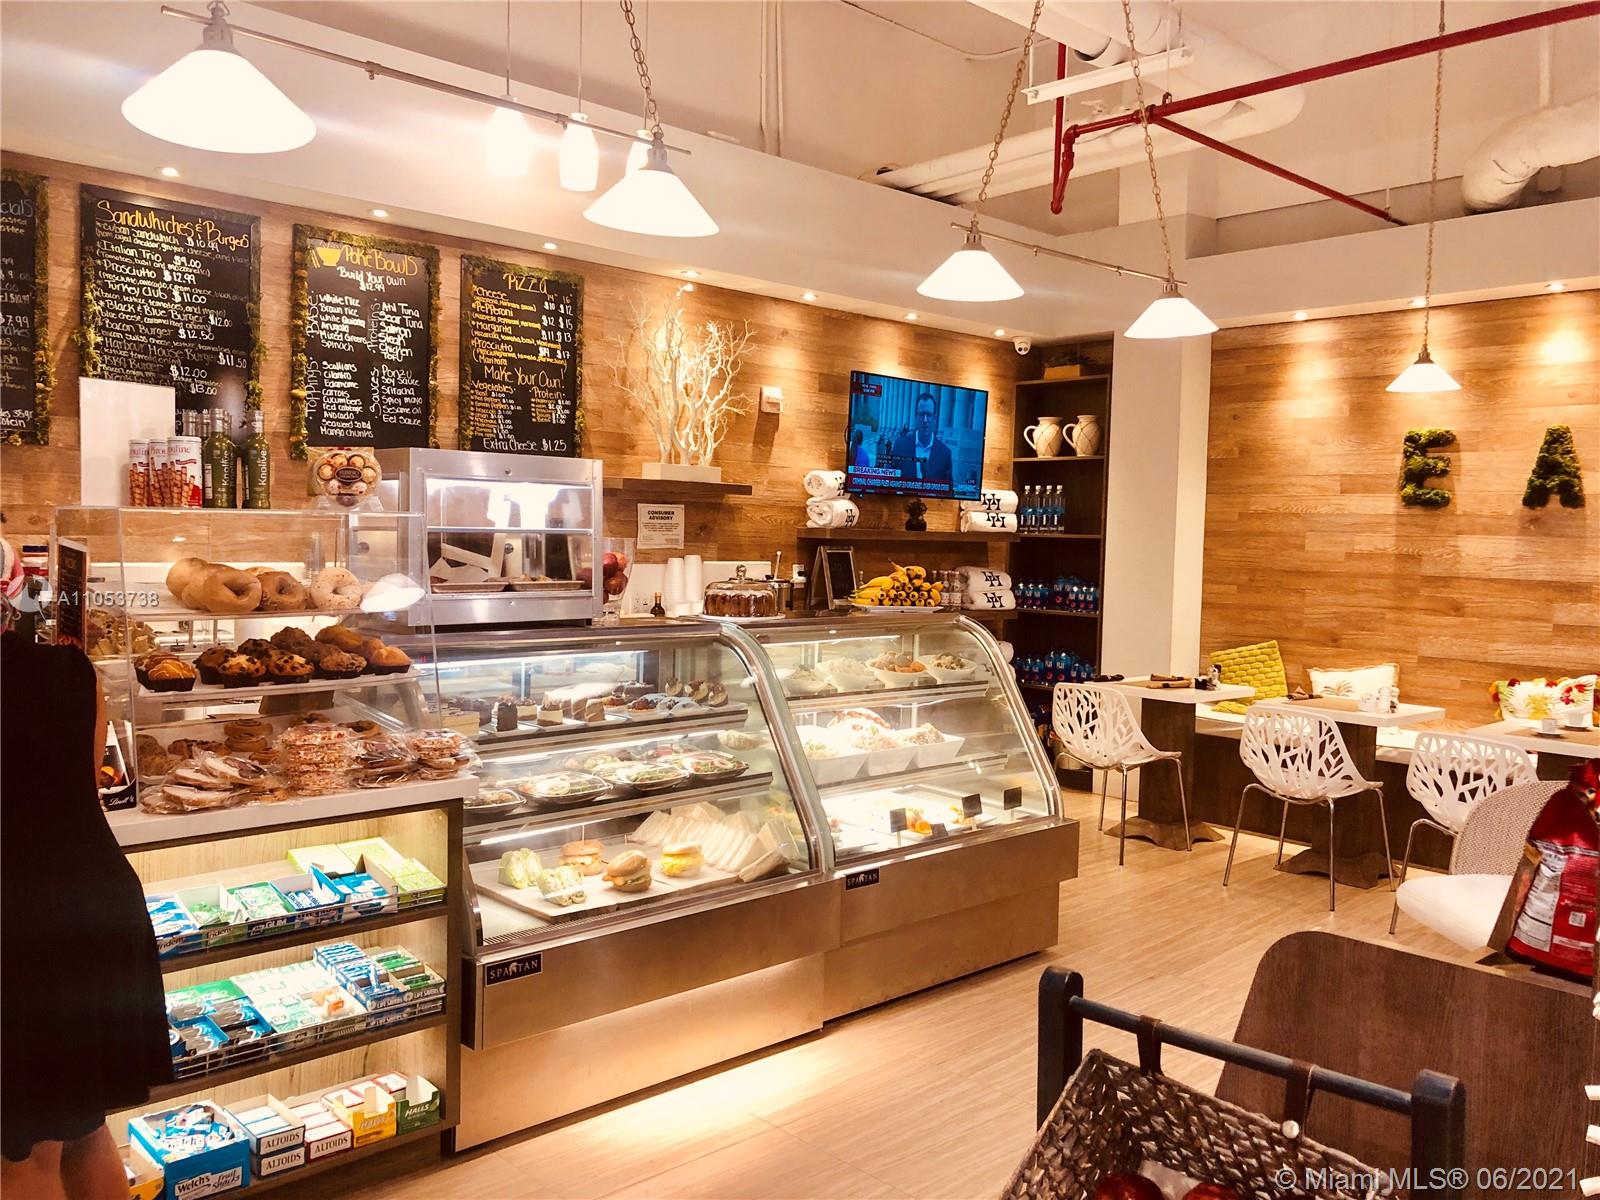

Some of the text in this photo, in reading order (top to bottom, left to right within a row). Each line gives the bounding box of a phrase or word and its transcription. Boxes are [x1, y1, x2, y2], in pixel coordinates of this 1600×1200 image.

[101, 240, 202, 269] Italian Trio $9.00
[163, 269, 197, 285] $12.99
[337, 265, 364, 282] Build
[141, 286, 168, 299] Club
[104, 299, 136, 313] Black
[142, 304, 168, 317] Blue
[397, 302, 421, 318] Tuna
[402, 315, 425, 330] Tuna
[177, 327, 216, 341] $12.50
[169, 364, 208, 379] $12.00
[381, 364, 413, 379] Ponzu
[483, 365, 514, 383] Make
[514, 366, 537, 386] Your
[531, 386, 563, 399] Protein
[382, 414, 397, 424] Eel
[541, 438, 567, 452] $1.25
[257, 449, 268, 486] Knolive
[881, 469, 897, 477] NEWS
[405, 1103, 430, 1118] HALLS
[264, 1132, 300, 1150] ALTOIDS
[314, 1136, 349, 1154] ALTOIDS
[265, 1152, 302, 1170] ALTOIDS
[177, 1175, 211, 1194] Welch's
